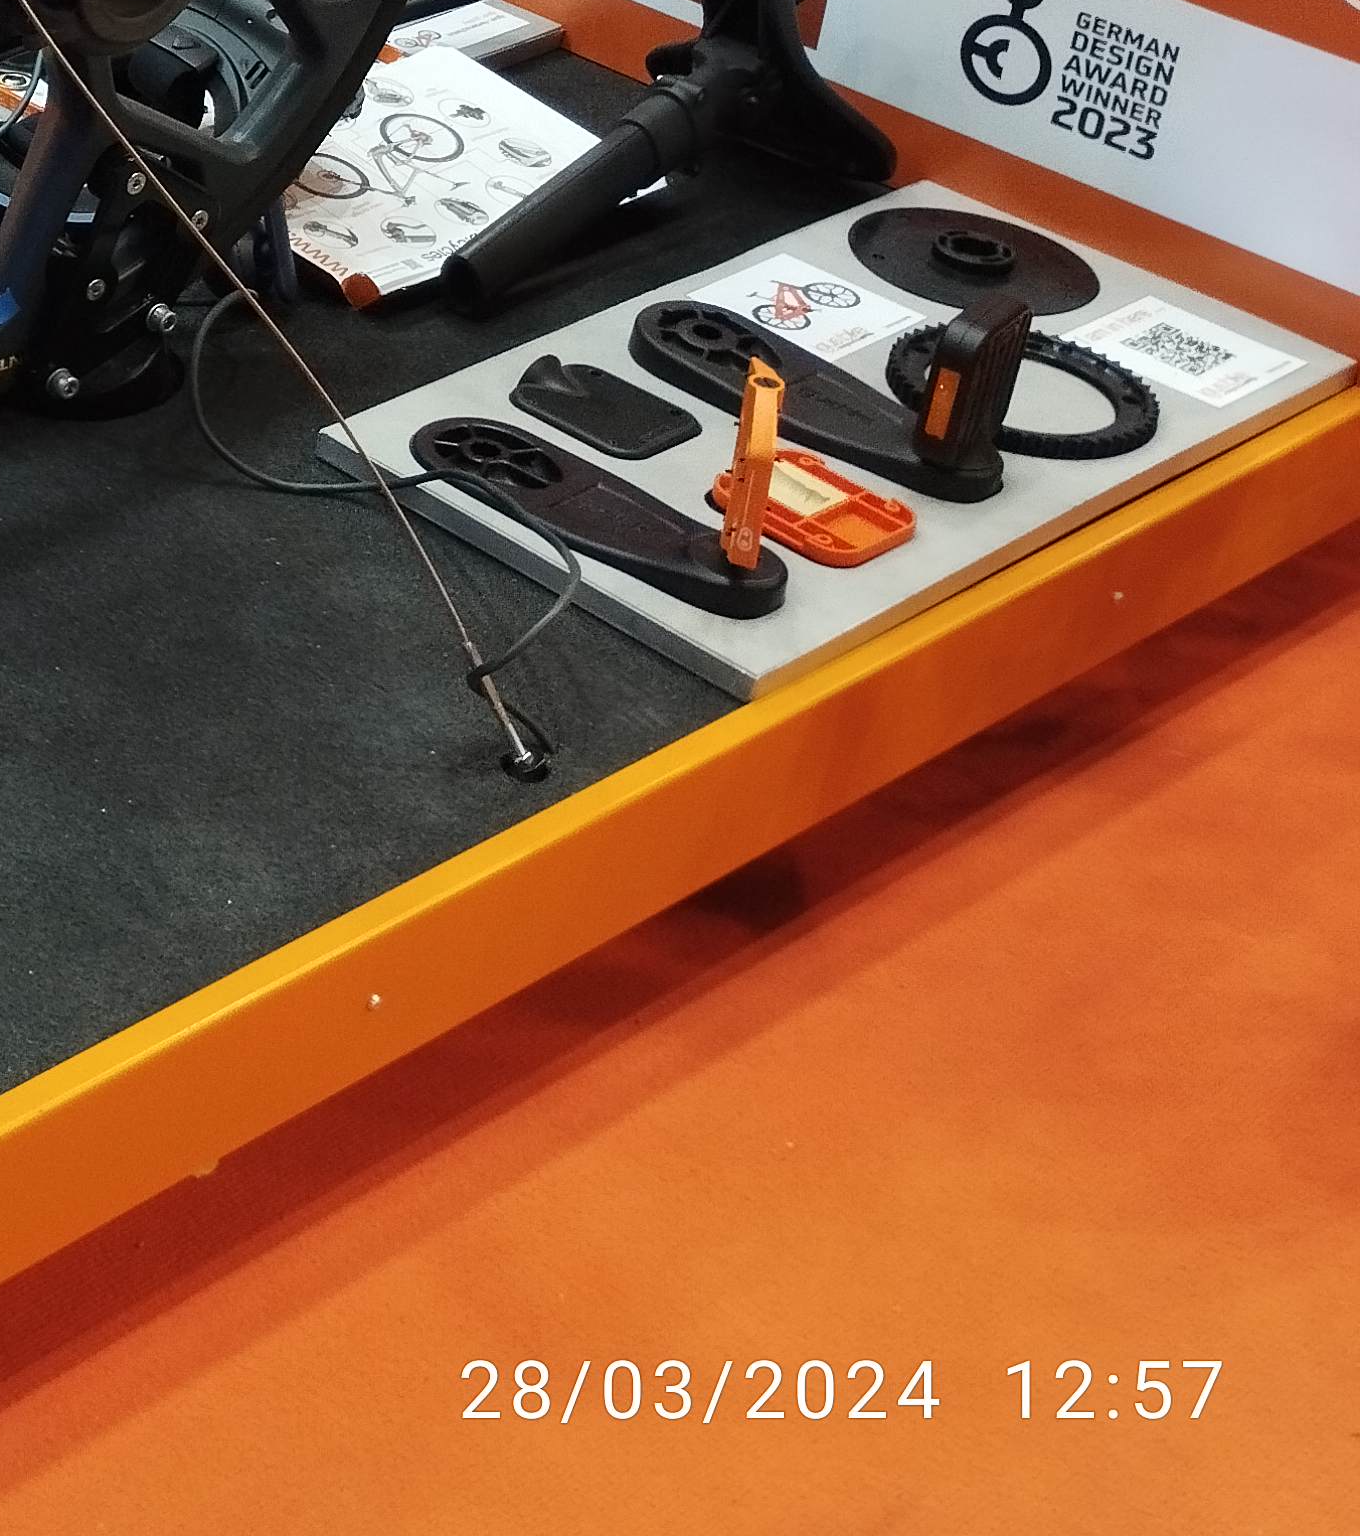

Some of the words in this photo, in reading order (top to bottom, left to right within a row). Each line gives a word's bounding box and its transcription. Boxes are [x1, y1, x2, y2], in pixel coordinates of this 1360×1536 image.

[1070, 30, 1174, 85] DESIGN
[1076, 11, 1180, 63] GERMAN
[1061, 74, 1162, 129] WINNER
[1064, 55, 1168, 107] AWARD
[1050, 96, 1158, 160] 2023
